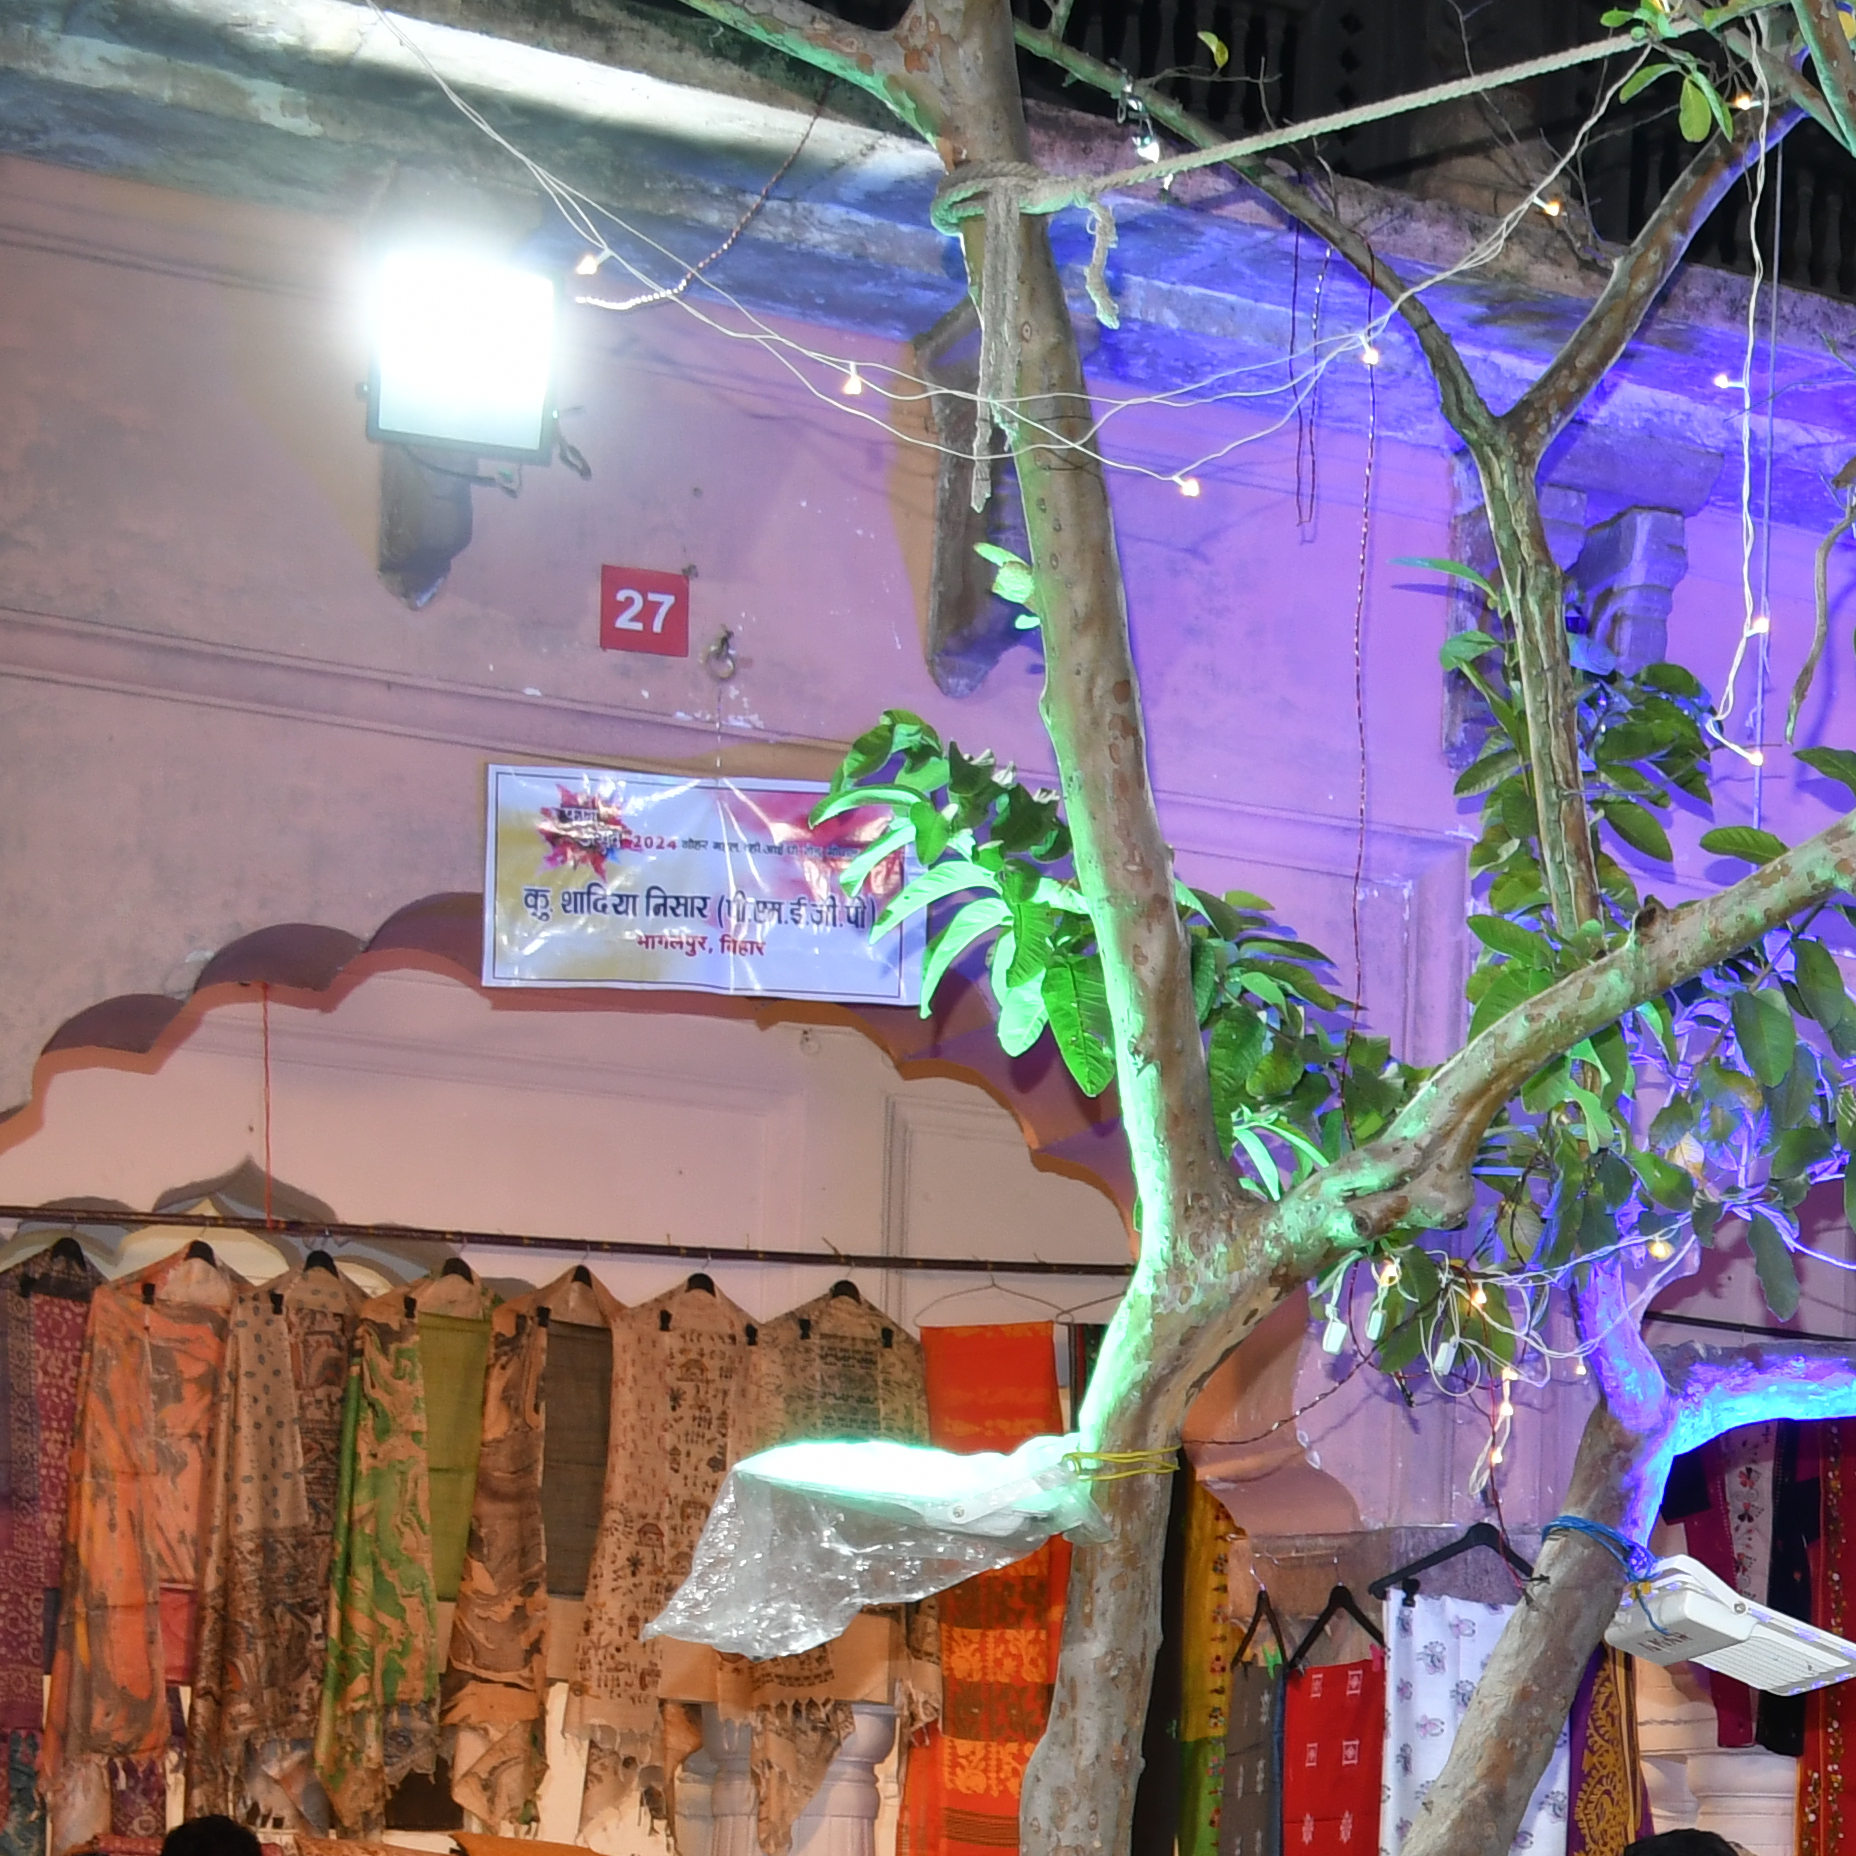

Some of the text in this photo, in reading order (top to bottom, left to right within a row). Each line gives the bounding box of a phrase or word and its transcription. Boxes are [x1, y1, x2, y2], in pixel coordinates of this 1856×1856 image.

[615, 589, 676, 634] 27
[633, 835, 678, 850] 2024
[561, 882, 641, 918] शादिया
[645, 886, 711, 919] निसार
